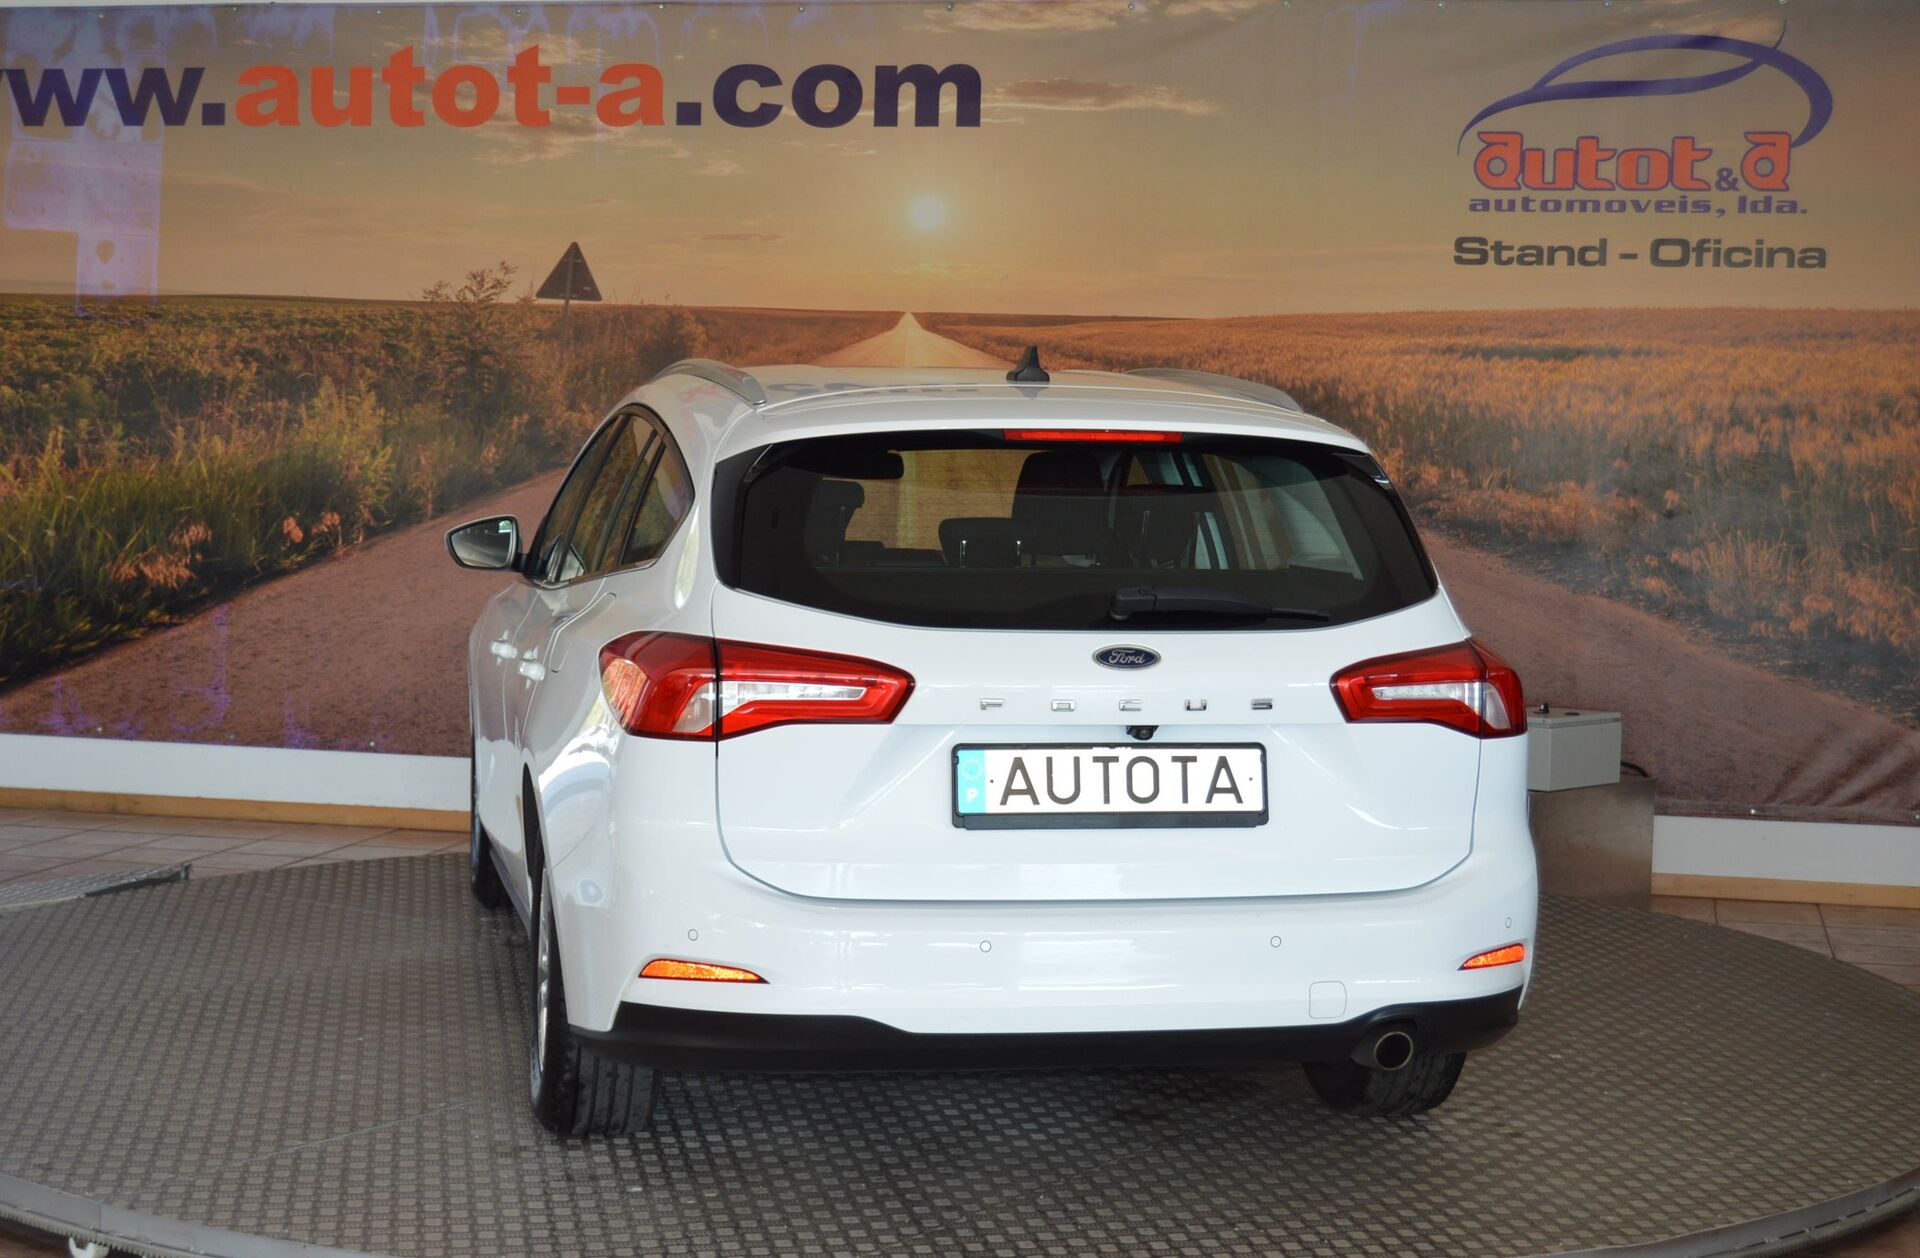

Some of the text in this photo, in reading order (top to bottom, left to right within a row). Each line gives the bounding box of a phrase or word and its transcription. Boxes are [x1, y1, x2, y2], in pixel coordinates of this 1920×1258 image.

[0, 44, 982, 128] ww.autot-a.com
[1468, 195, 1808, 217] automoveis, lda.
[1453, 236, 1607, 267] Stand
[1649, 238, 1828, 269] Oficina
[1108, 649, 1145, 665] Ford
[980, 698, 1273, 712] FOCUS
[999, 755, 1244, 806] AUTOTA
